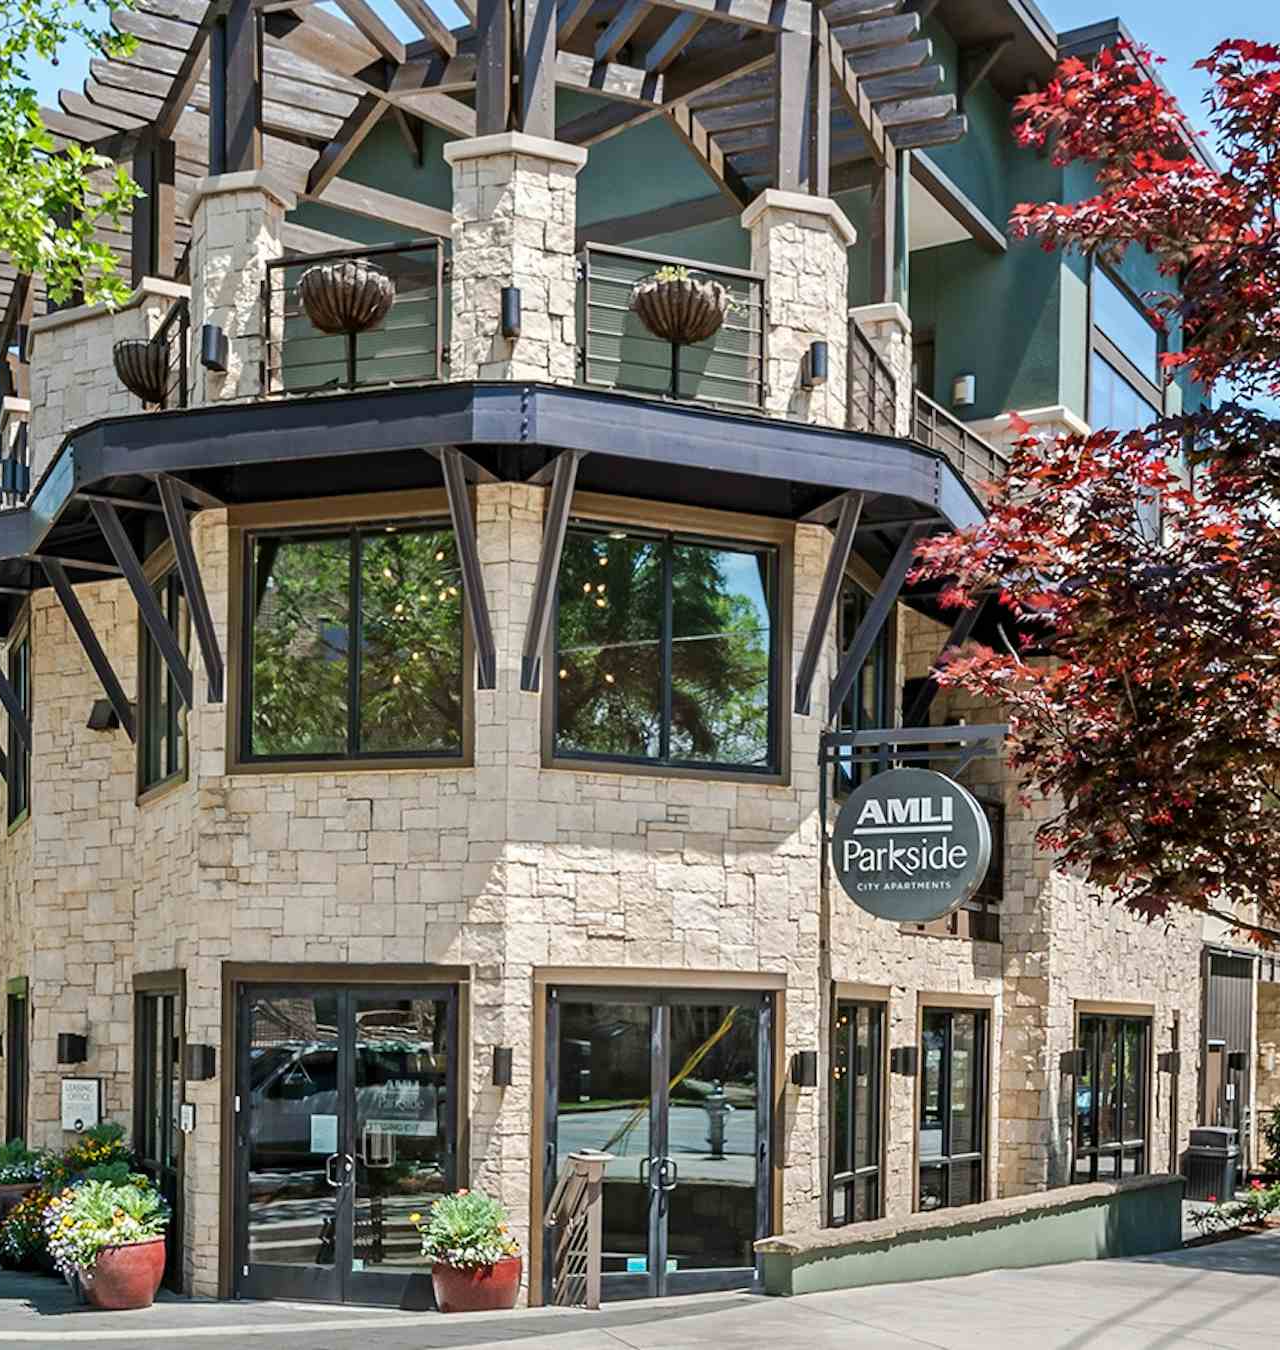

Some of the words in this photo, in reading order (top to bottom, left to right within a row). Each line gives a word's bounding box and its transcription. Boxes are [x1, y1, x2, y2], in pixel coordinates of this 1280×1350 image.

[856, 796, 953, 825] AMLI
[842, 836, 968, 876] Parkside
[856, 882, 881, 892] CITY
[883, 880, 952, 890] APARTMENTS
